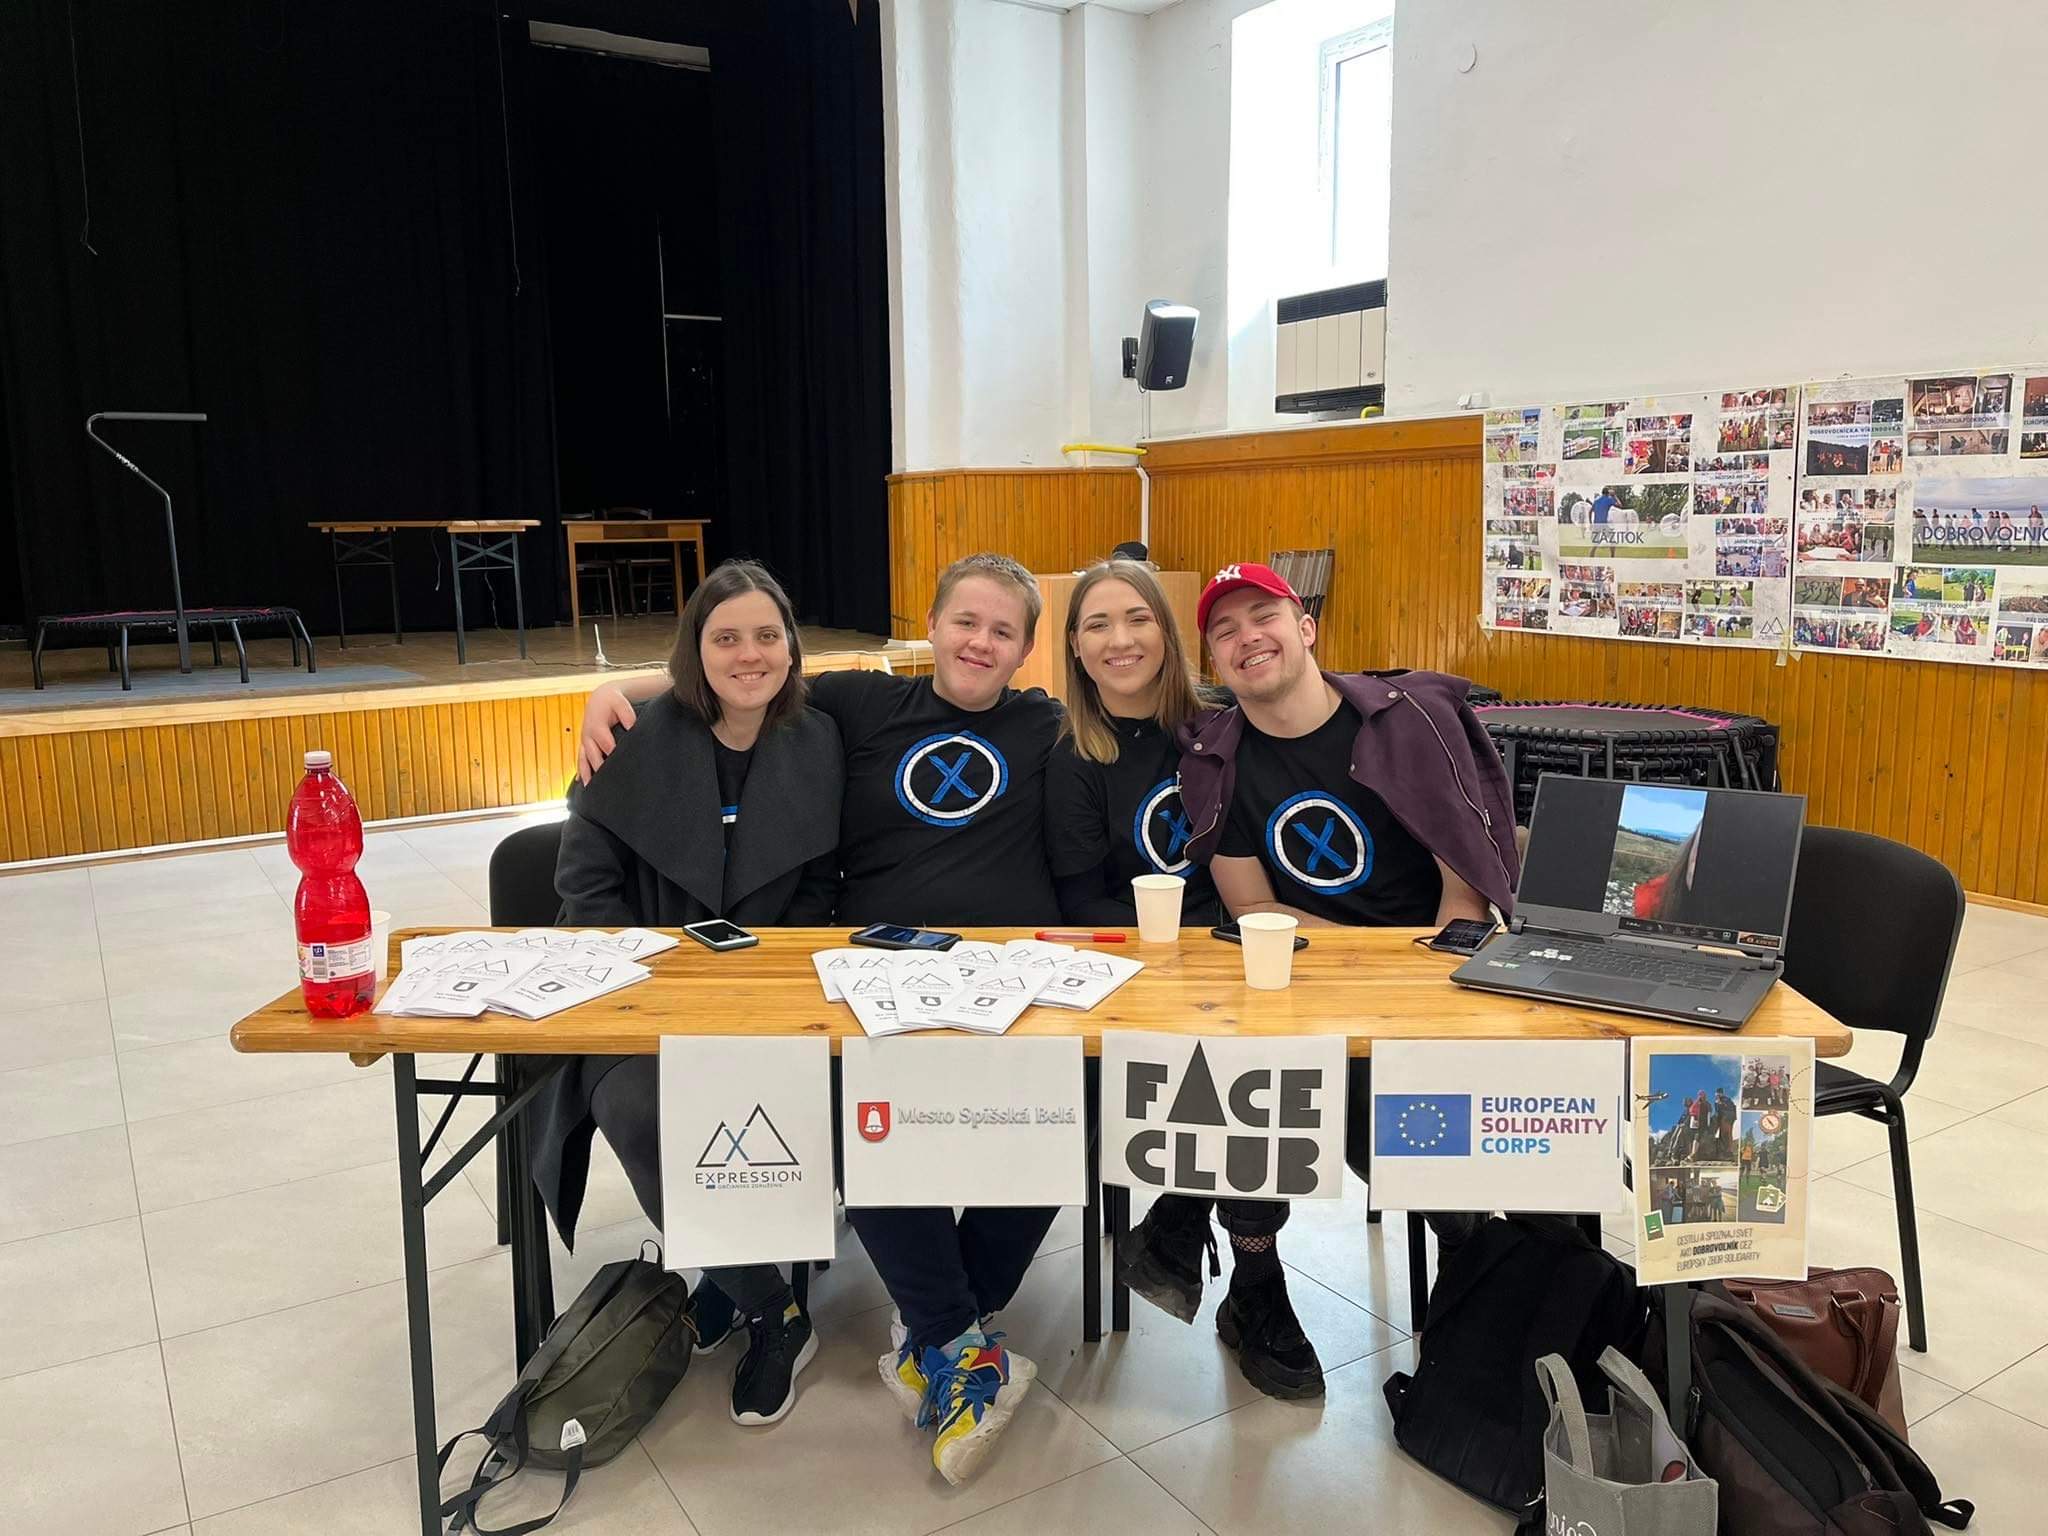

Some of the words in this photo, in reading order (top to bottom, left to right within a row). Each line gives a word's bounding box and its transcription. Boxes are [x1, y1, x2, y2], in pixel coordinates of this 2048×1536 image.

[1125, 1039, 1323, 1129] FACE
[1481, 1097, 1596, 1114] EUROPEAN
[898, 1107, 954, 1125] Mesto
[959, 1106, 1030, 1129] Spišská
[1035, 1106, 1076, 1125] Belá
[1481, 1117, 1608, 1134] SOLIDARITY
[1481, 1137, 1551, 1154] CORPS
[1124, 1129, 1320, 1195] CLUB
[695, 1170, 802, 1184] EXPRESSION
